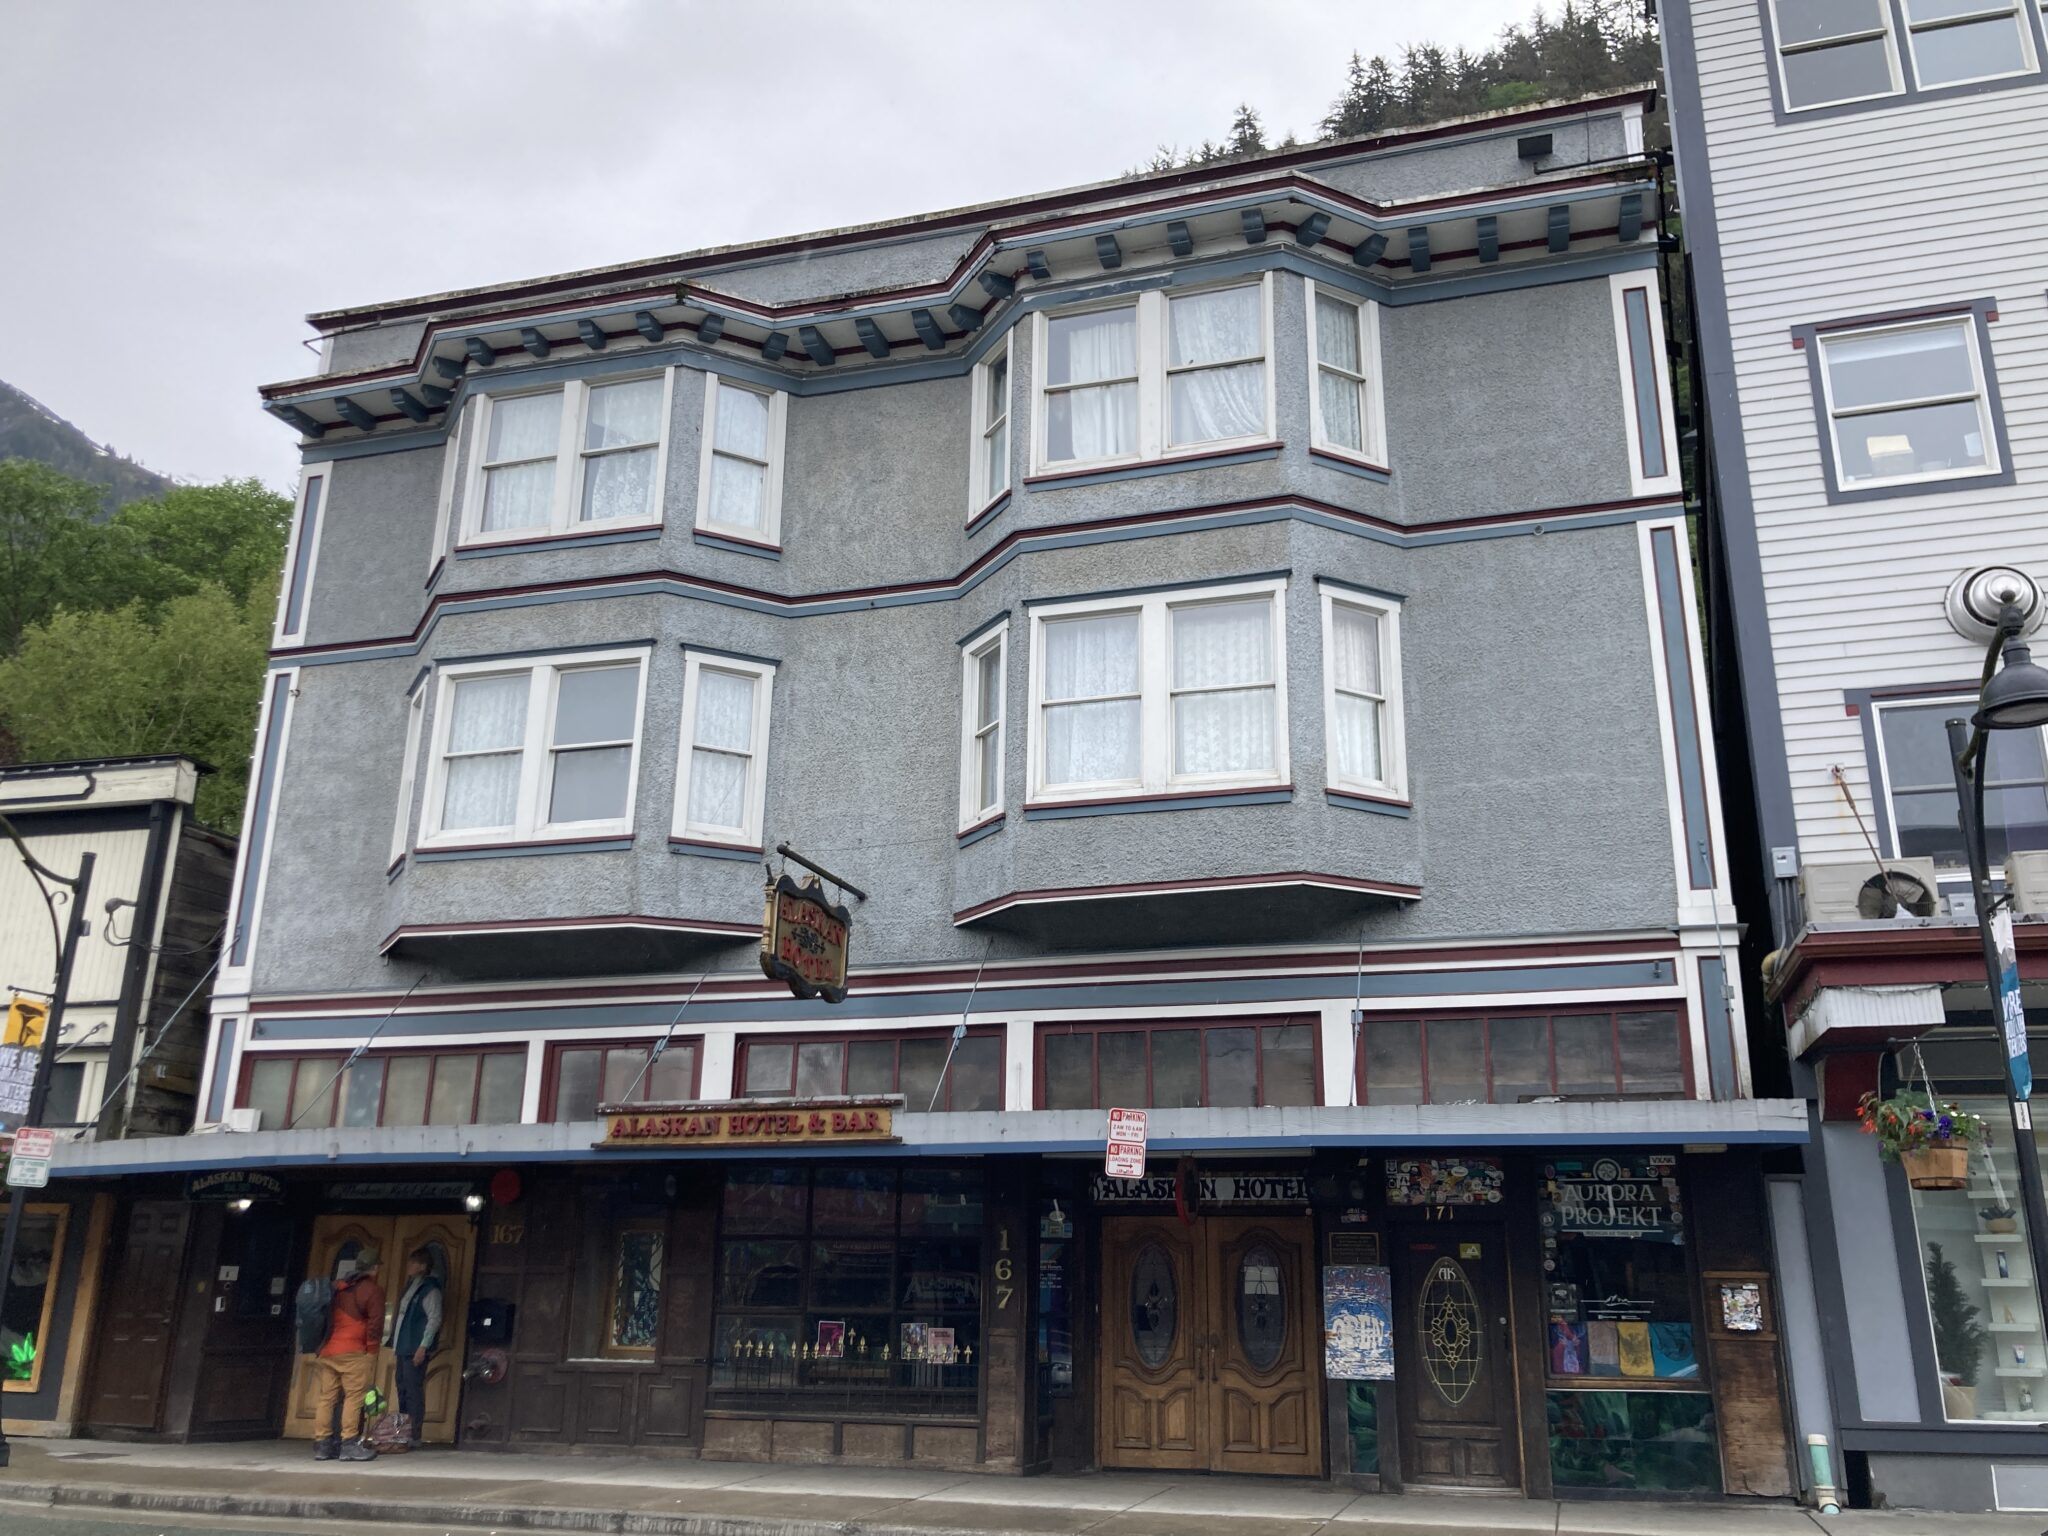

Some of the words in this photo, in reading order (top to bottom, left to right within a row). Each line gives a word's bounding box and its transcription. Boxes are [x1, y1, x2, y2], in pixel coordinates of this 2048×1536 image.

[612, 1117, 720, 1138] ALASKAN
[728, 1114, 804, 1135] HOTEL
[808, 1113, 825, 1132] &
[831, 1110, 883, 1132] BAR
[1122, 1112, 1145, 1122] PARKING
[1120, 1146, 1143, 1156] PARKING
[1103, 1179, 1215, 1199] ALASN
[1234, 1178, 1309, 1199] HOTEL
[1564, 1184, 1656, 1201] AURORA
[1425, 1205, 1453, 1220] 171
[1560, 1206, 1662, 1227] PROJEKT
[490, 1224, 524, 1244] 167
